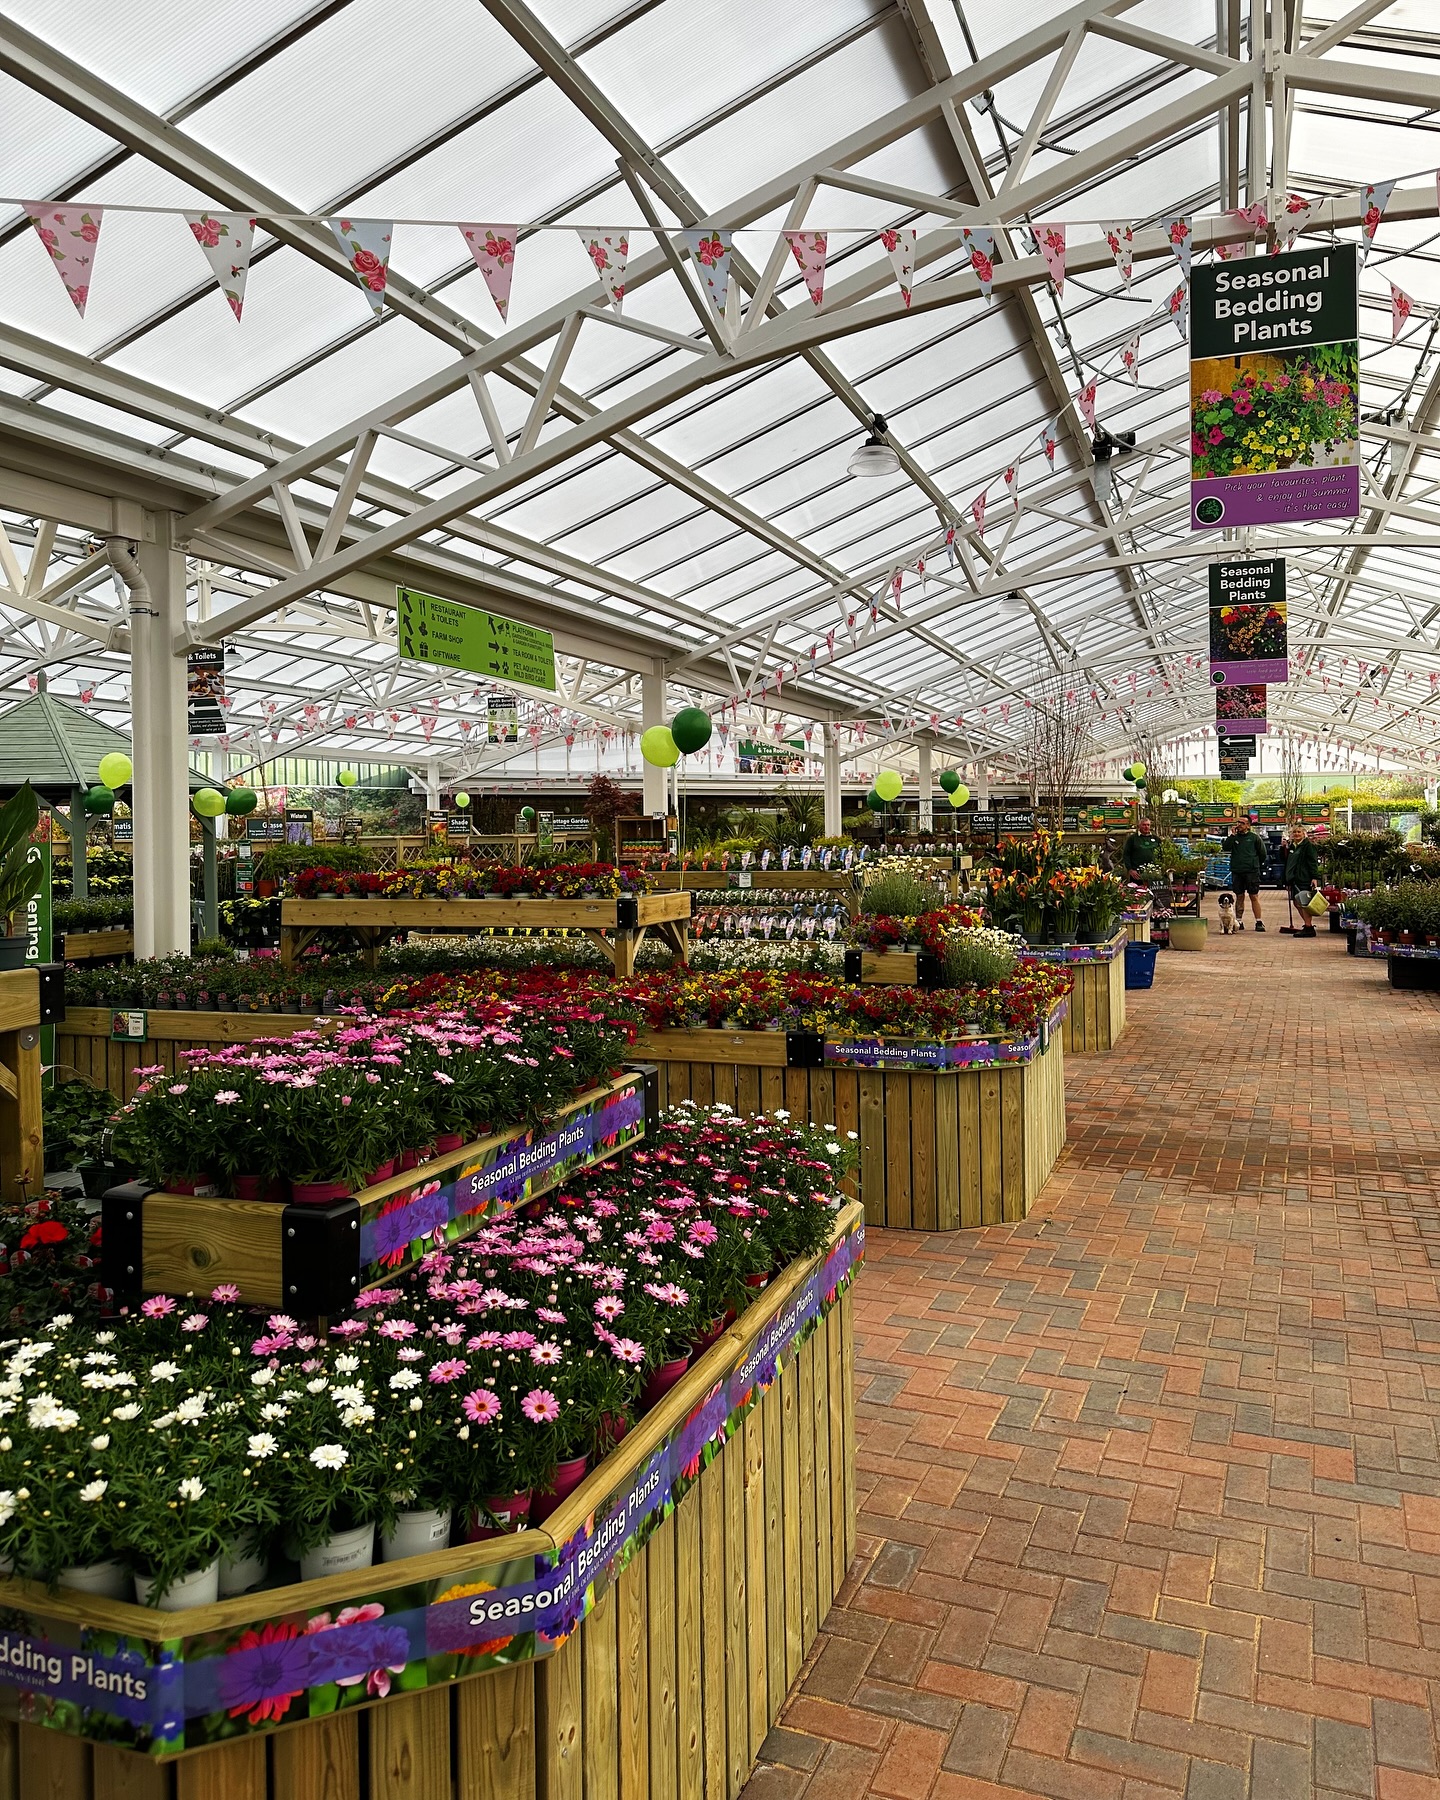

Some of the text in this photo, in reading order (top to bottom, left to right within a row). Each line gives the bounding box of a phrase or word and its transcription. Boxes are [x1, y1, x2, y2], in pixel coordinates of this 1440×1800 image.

[1215, 256, 1329, 293] Seasonal
[1215, 290, 1322, 319] Bedding
[1234, 318, 1313, 343] Plants
[1224, 474, 1346, 492] Pick your favourites, plant
[1268, 492, 1293, 503] enjoy
[1296, 488, 1308, 498] all
[1312, 487, 1352, 498] Summer
[1284, 502, 1298, 512] it's
[1303, 502, 1322, 512] that
[1327, 498, 1352, 510] easy!
[1220, 562, 1274, 577] Seasonal
[1220, 577, 1270, 590] Bedding
[1230, 590, 1266, 601] Plants
[431, 602, 466, 619] RESTAURANT
[431, 613, 459, 627] & TOILETS
[432, 630, 463, 644] FARM SHOP
[512, 624, 534, 638] PLATFORM
[432, 649, 461, 662] GIFTWARE
[513, 648, 522, 657] TEA
[522, 651, 534, 660] ROOM
[538, 656, 553, 666] TOILETS
[514, 670, 546, 684] WILD BIRD CARE
[523, 664, 542, 676] AQUATICS
[835, 1045, 871, 1055] Seasonal
[874, 1047, 908, 1058] Bedding
[911, 1049, 937, 1058] Plants
[471, 1127, 584, 1194] Seasonal Bedding Plants
[740, 1340, 770, 1384] Seasonal
[770, 1311, 796, 1348] Bedding
[796, 1290, 813, 1315] Plants
[470, 1469, 660, 1626] Seasonal Bedding Plants
[565, 1539, 619, 1606] AT THE OLD RAILWAY LINE
[0, 1636, 147, 1700] dding Plants
